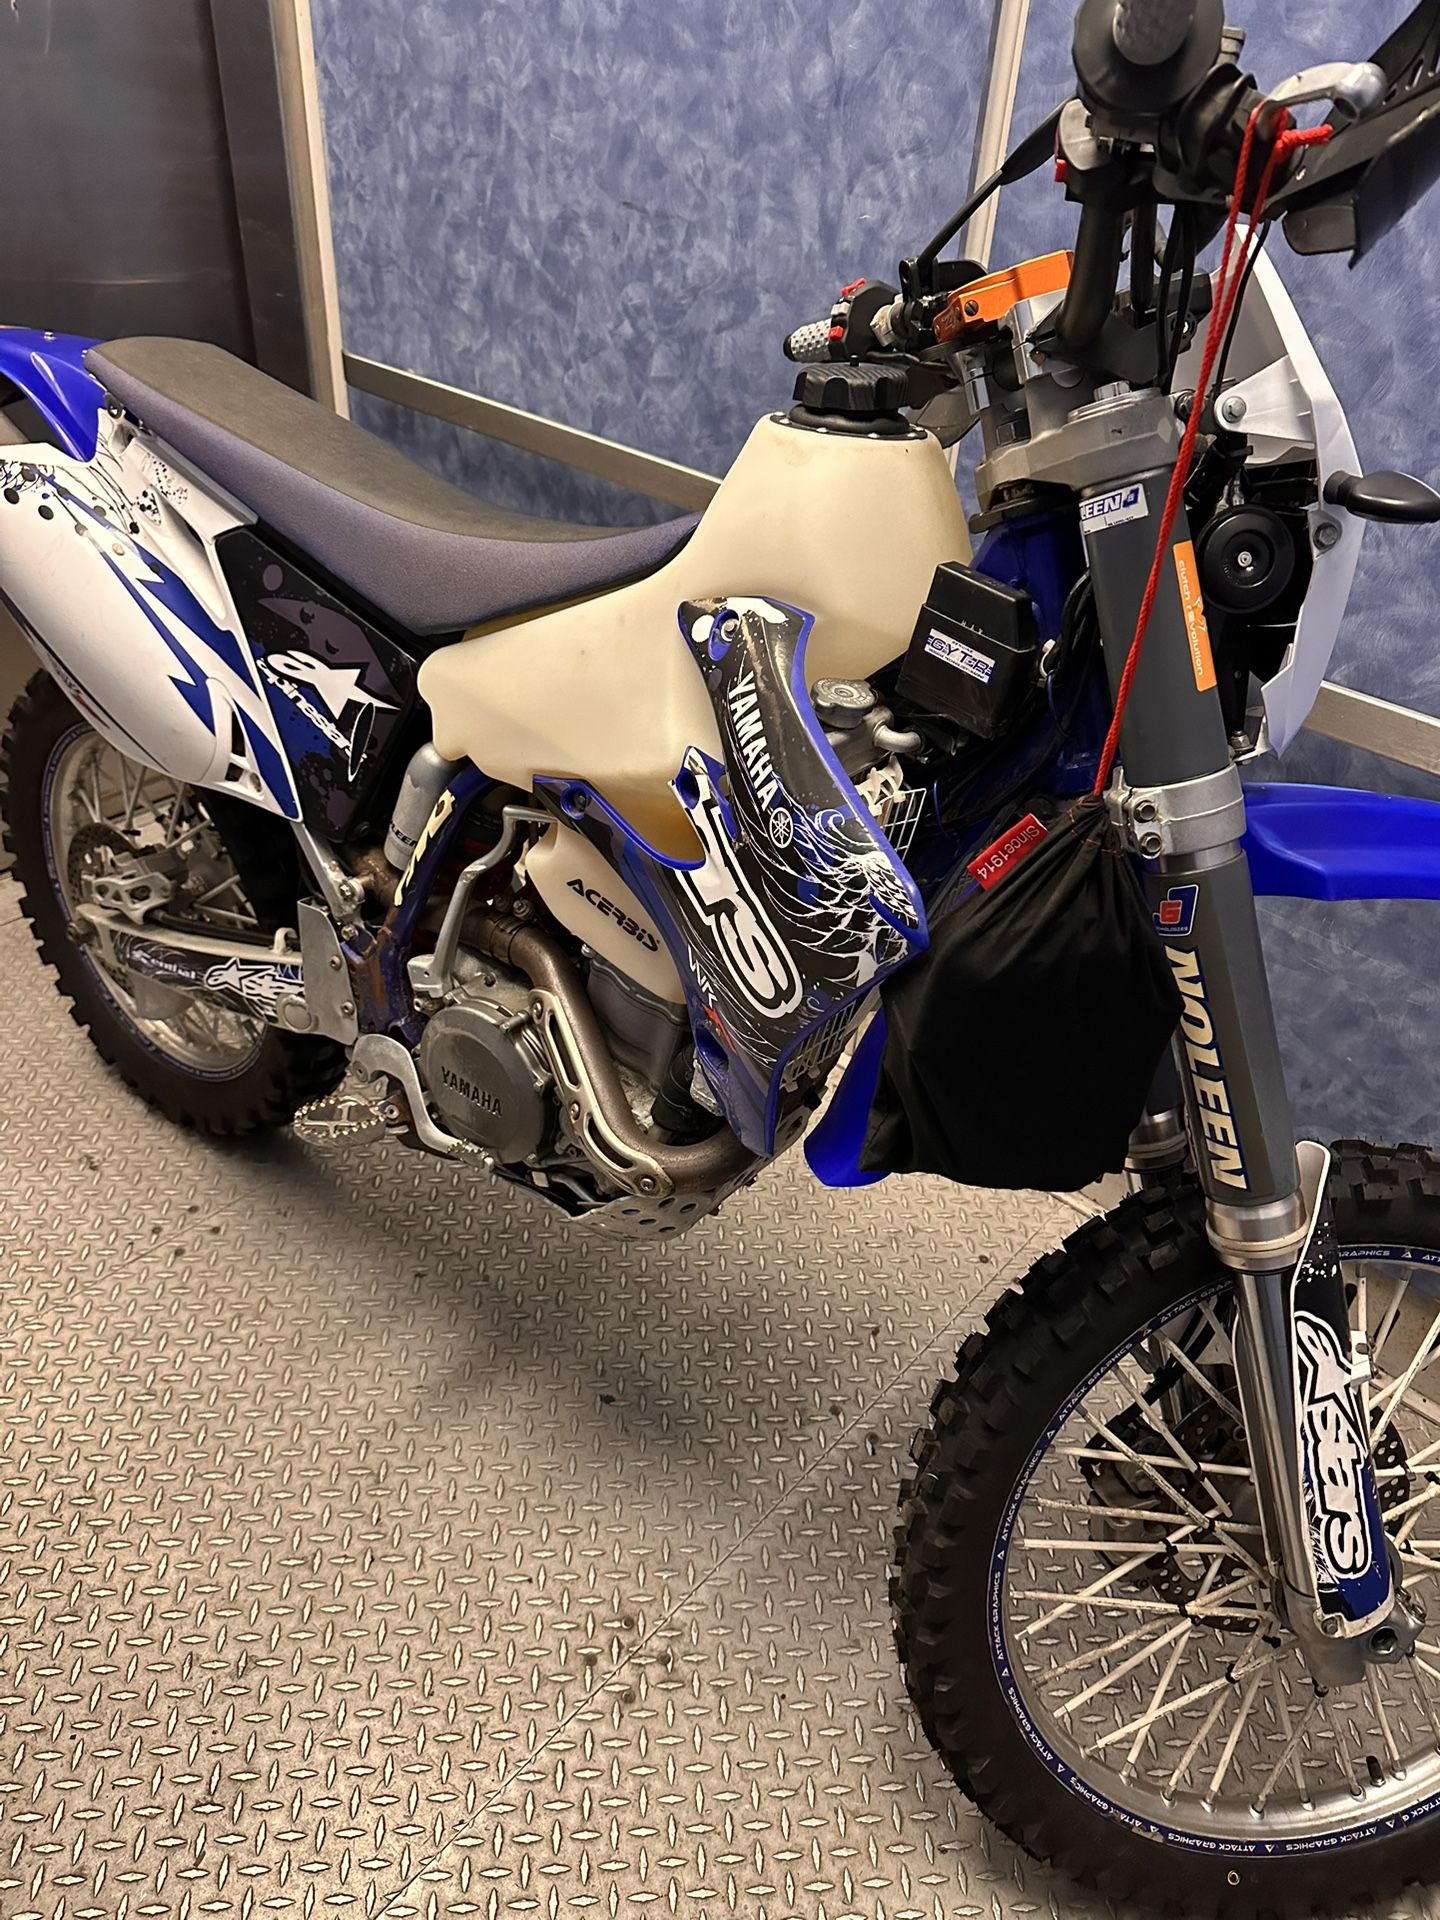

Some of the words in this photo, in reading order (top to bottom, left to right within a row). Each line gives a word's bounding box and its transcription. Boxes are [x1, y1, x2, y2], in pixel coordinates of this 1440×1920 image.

[1178, 559, 1191, 601] clutch
[729, 671, 779, 812] YAMAHA
[977, 825, 1040, 880] Since1914
[1164, 945, 1248, 1190] NOLEEN
[441, 1066, 502, 1116] YAMAHA
[1057, 1385, 1089, 1422] ATTACK
[1000, 1502, 1018, 1541] ATTACK
[992, 1624, 1005, 1661] ATTACK
[1027, 1730, 1054, 1762] ATTACK
[1411, 1797, 1440, 1818] TTACK
[1217, 1841, 1256, 1853] ATTACK
[1339, 1825, 1379, 1844] ATTACK
